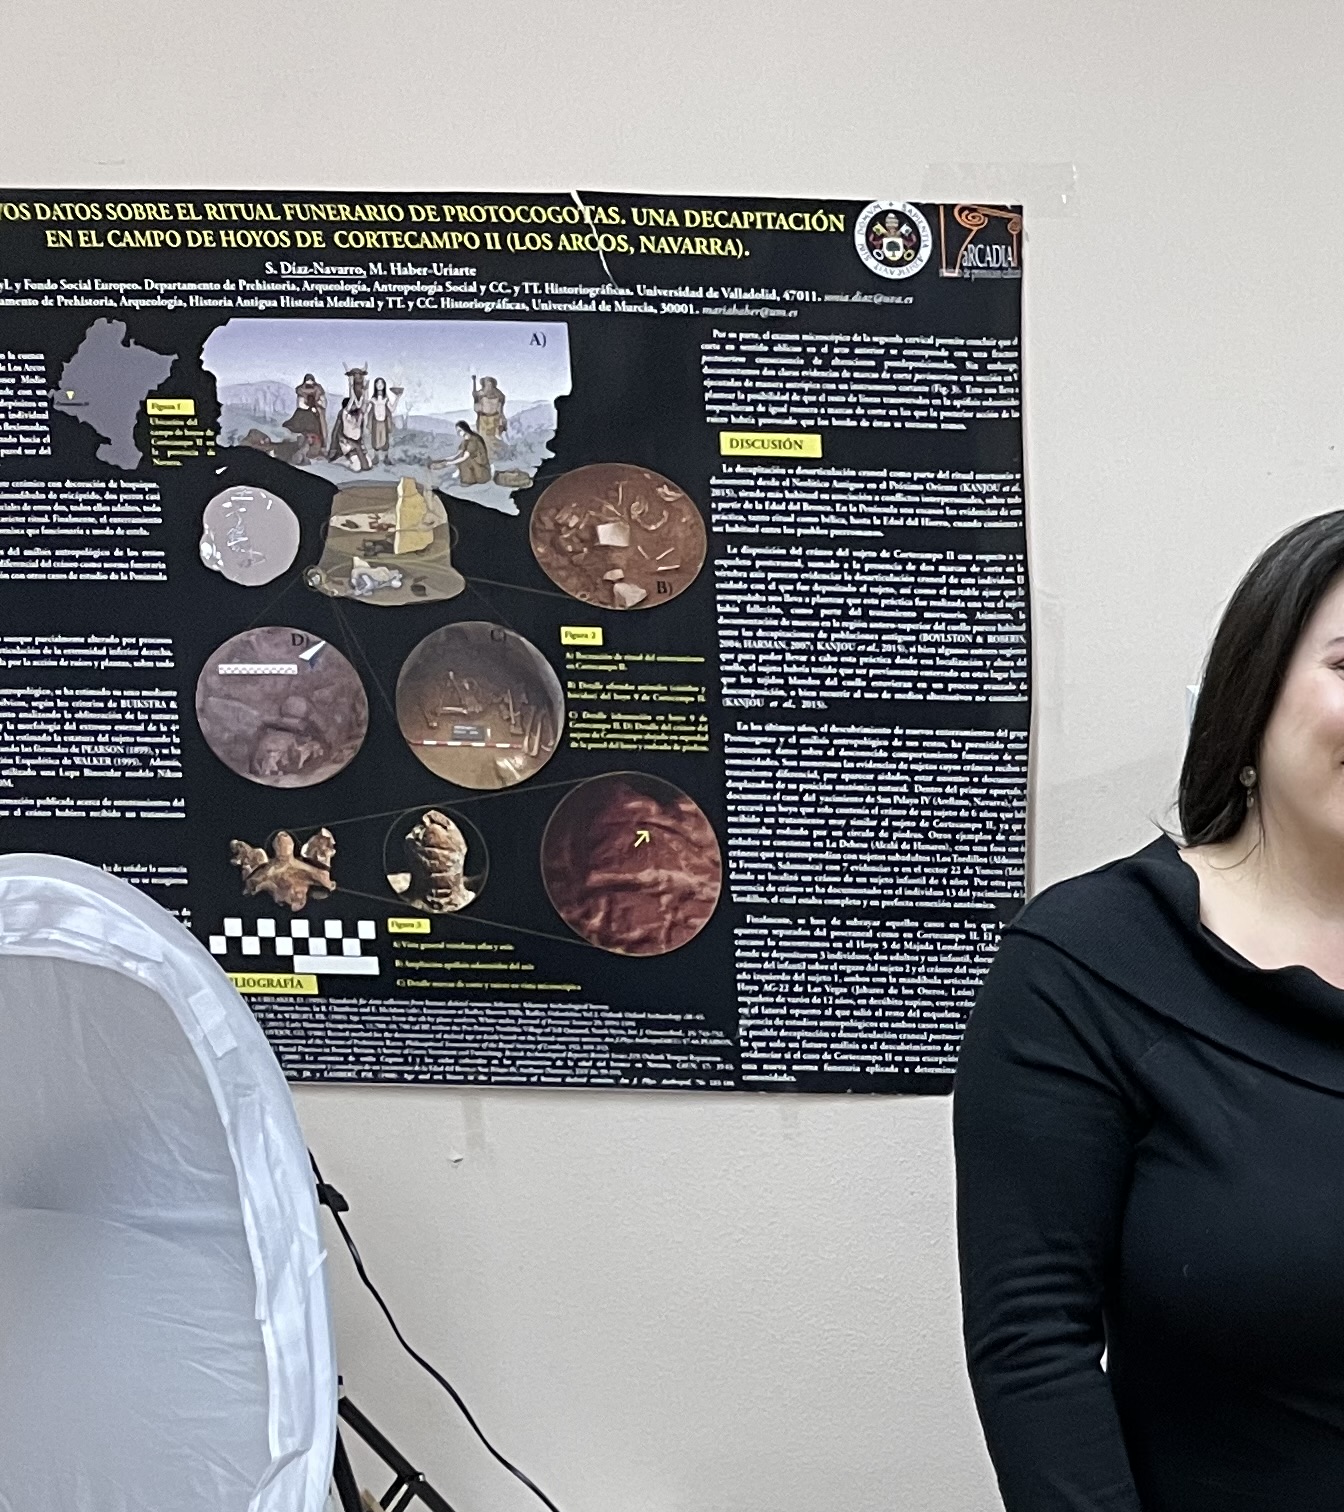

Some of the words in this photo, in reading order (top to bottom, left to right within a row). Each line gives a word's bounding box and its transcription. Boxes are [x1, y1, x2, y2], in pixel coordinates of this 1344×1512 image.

[0, 203, 31, 221] OS
[34, 203, 102, 221] DATOS
[105, 203, 173, 221] SOBRE
[175, 203, 202, 221] EL
[203, 203, 281, 221] RITUAL
[283, 204, 404, 222] FUNERARIO
[408, 205, 441, 223] DE
[442, 205, 627, 225] PROTOCOGOTAS.
[631, 208, 679, 227] UNA
[684, 209, 846, 232] DECAPITACIÓN
[45, 230, 73, 248] EN
[77, 230, 103, 248] EL
[106, 230, 182, 248] CAMPO
[186, 231, 216, 248] DE
[220, 231, 290, 248] HOYOS
[295, 231, 325, 248] DE
[333, 231, 480, 250] CORTECAMPO
[483, 233, 501, 250] II
[507, 232, 552, 253] (LOS
[557, 233, 635, 255] ARCOS,
[640, 235, 750, 259] NAVARRA).
[265, 262, 278, 275] S.
[369, 262, 387, 276] M.
[390, 262, 476, 277] Haber-Uriarte
[24, 279, 58, 291] Fondo
[60, 279, 91, 291] Social
[144, 279, 220, 294] Departamento
[222, 280, 236, 291] de
[238, 279, 299, 293] Prehistoria,
[445, 281, 477, 293] Social
[637, 284, 703, 298] Universidad
[706, 286, 719, 298] de
[41, 296, 54, 308] de
[57, 296, 118, 309] Prehistoria,
[189, 296, 233, 308] Historia
[235, 296, 278, 311] Antigua
[280, 297, 324, 308] Historia
[327, 297, 374, 309] Medieval
[532, 299, 597, 313] Universidad
[730, 438, 804, 450] DISCUSIÓN
